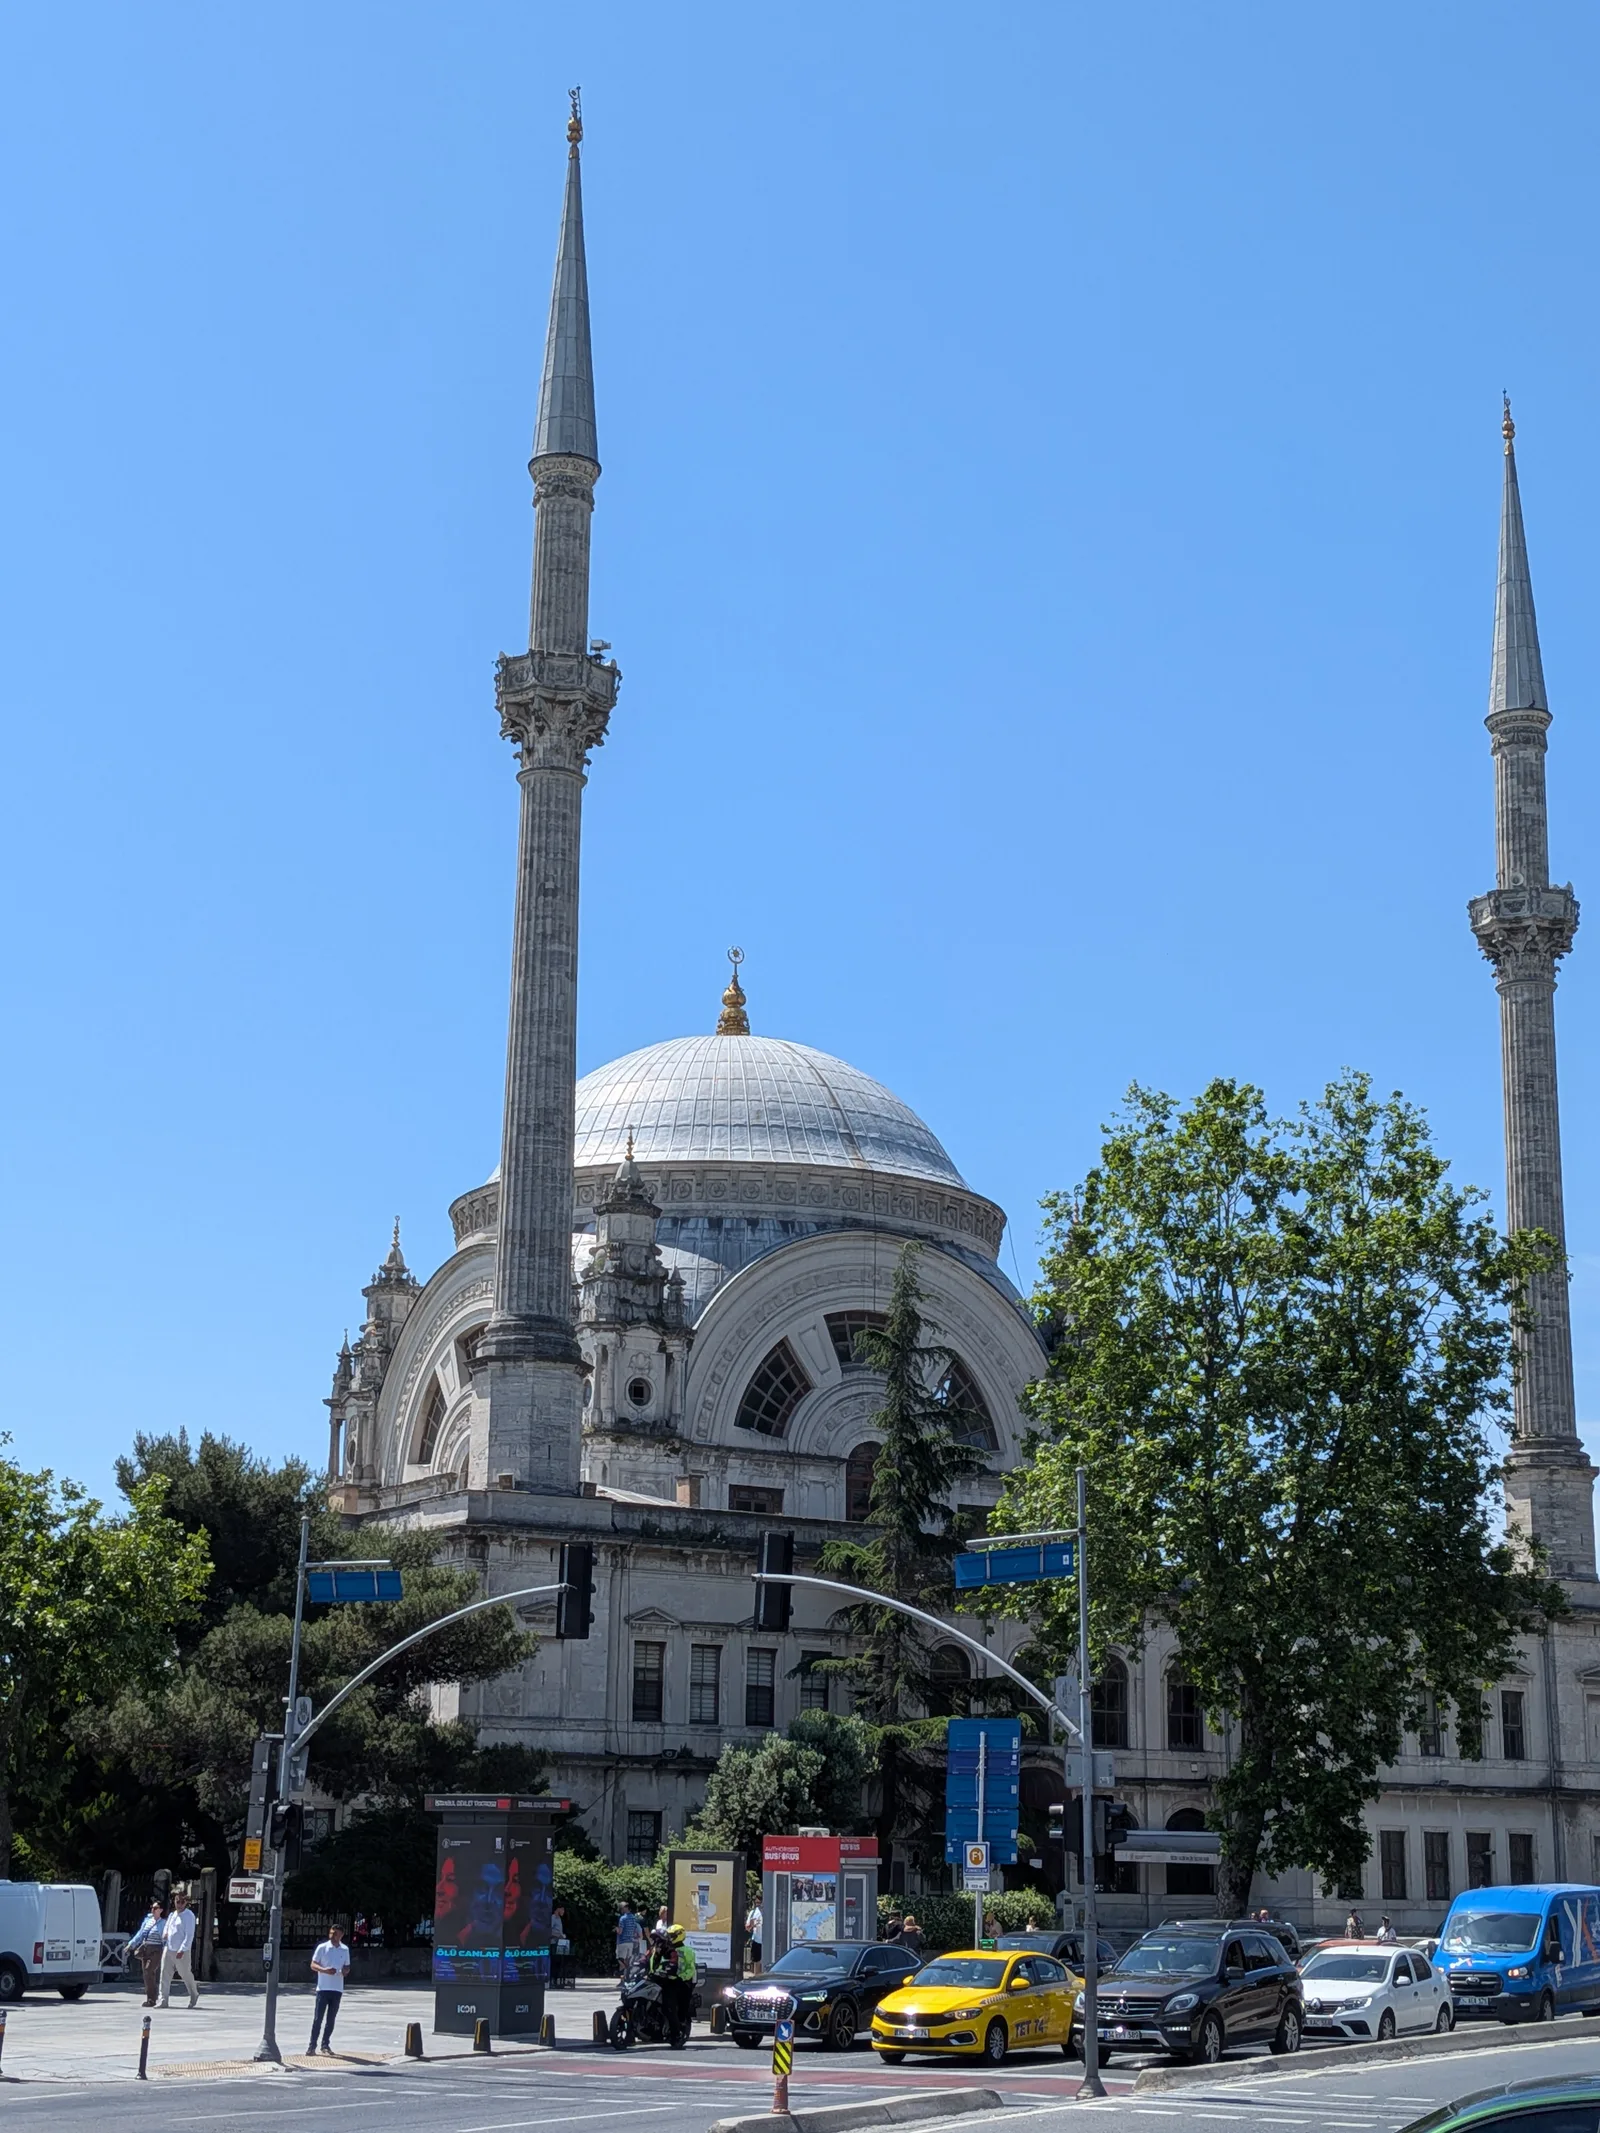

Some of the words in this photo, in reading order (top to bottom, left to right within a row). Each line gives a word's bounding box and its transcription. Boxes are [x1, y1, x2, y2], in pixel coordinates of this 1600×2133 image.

[436, 1948, 456, 1957] ÖLÜ
[458, 1949, 500, 1958] CANLAR
[1015, 2019, 1031, 2038] TET
